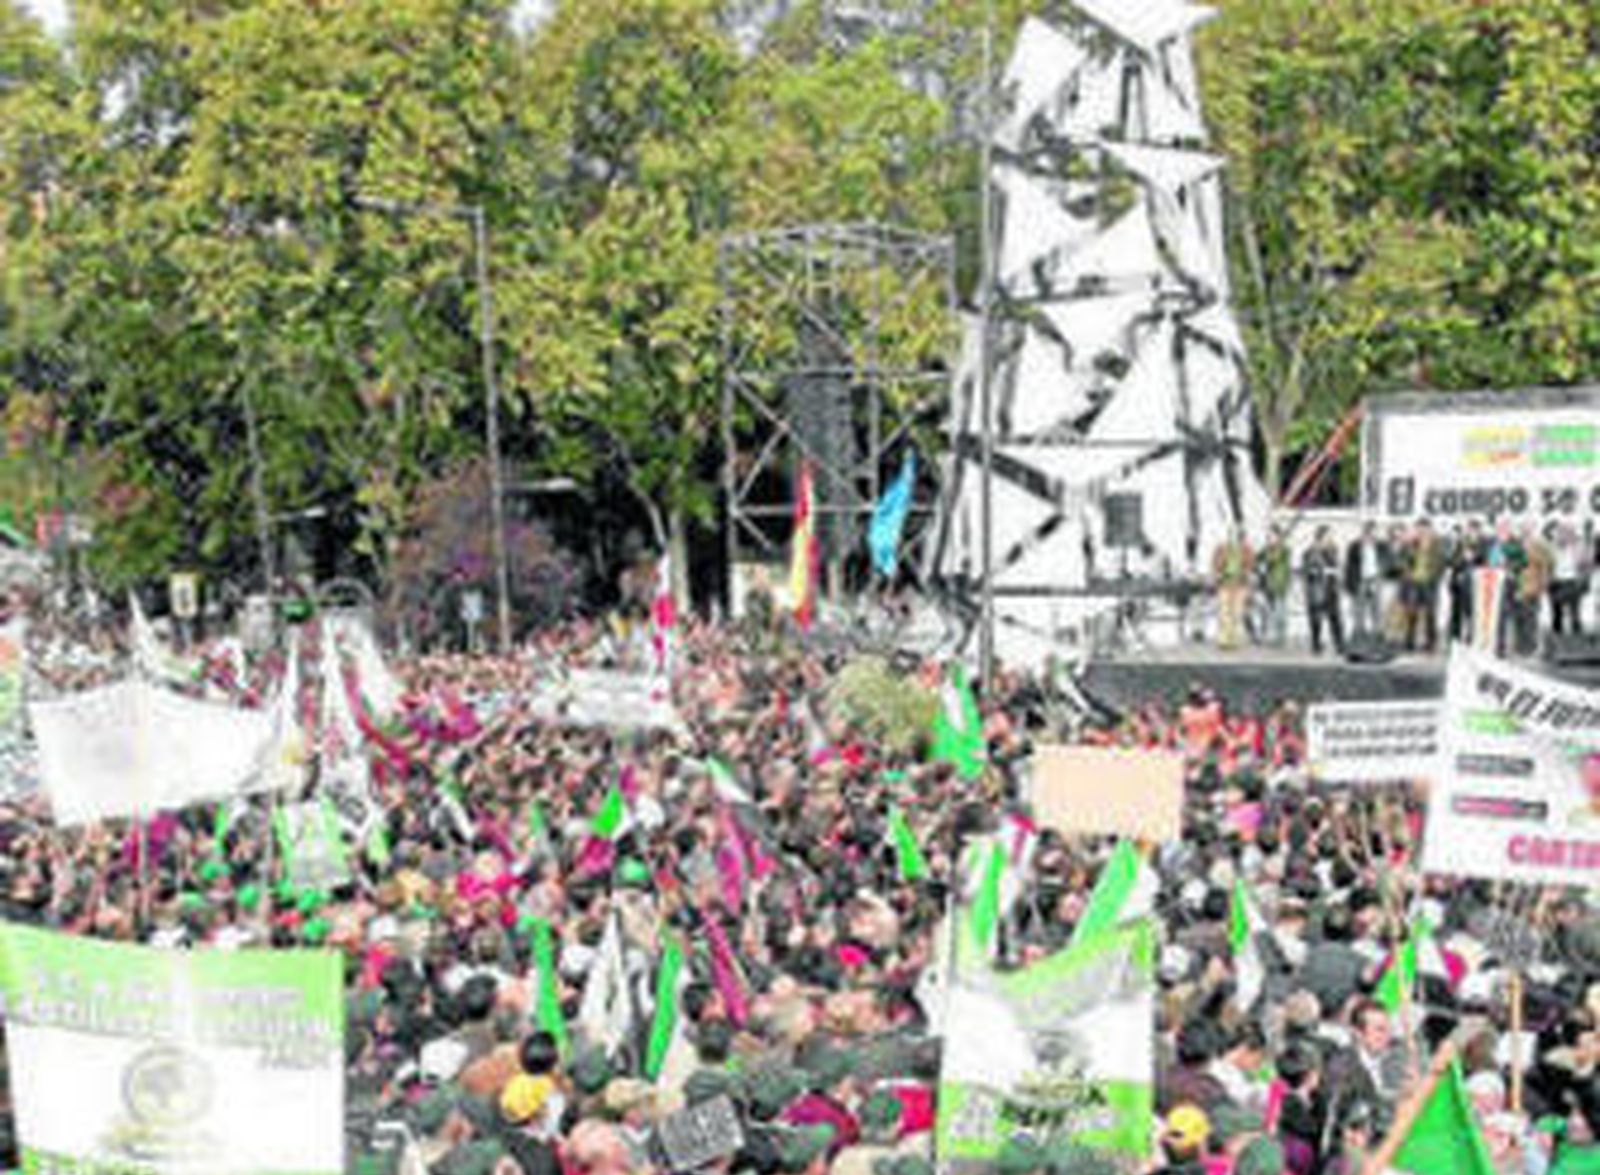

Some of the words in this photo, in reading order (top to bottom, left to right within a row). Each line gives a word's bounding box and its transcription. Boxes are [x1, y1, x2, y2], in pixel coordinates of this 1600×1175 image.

[1387, 475, 1415, 516] El
[1424, 487, 1529, 524] campo
[1541, 488, 1580, 516] se
